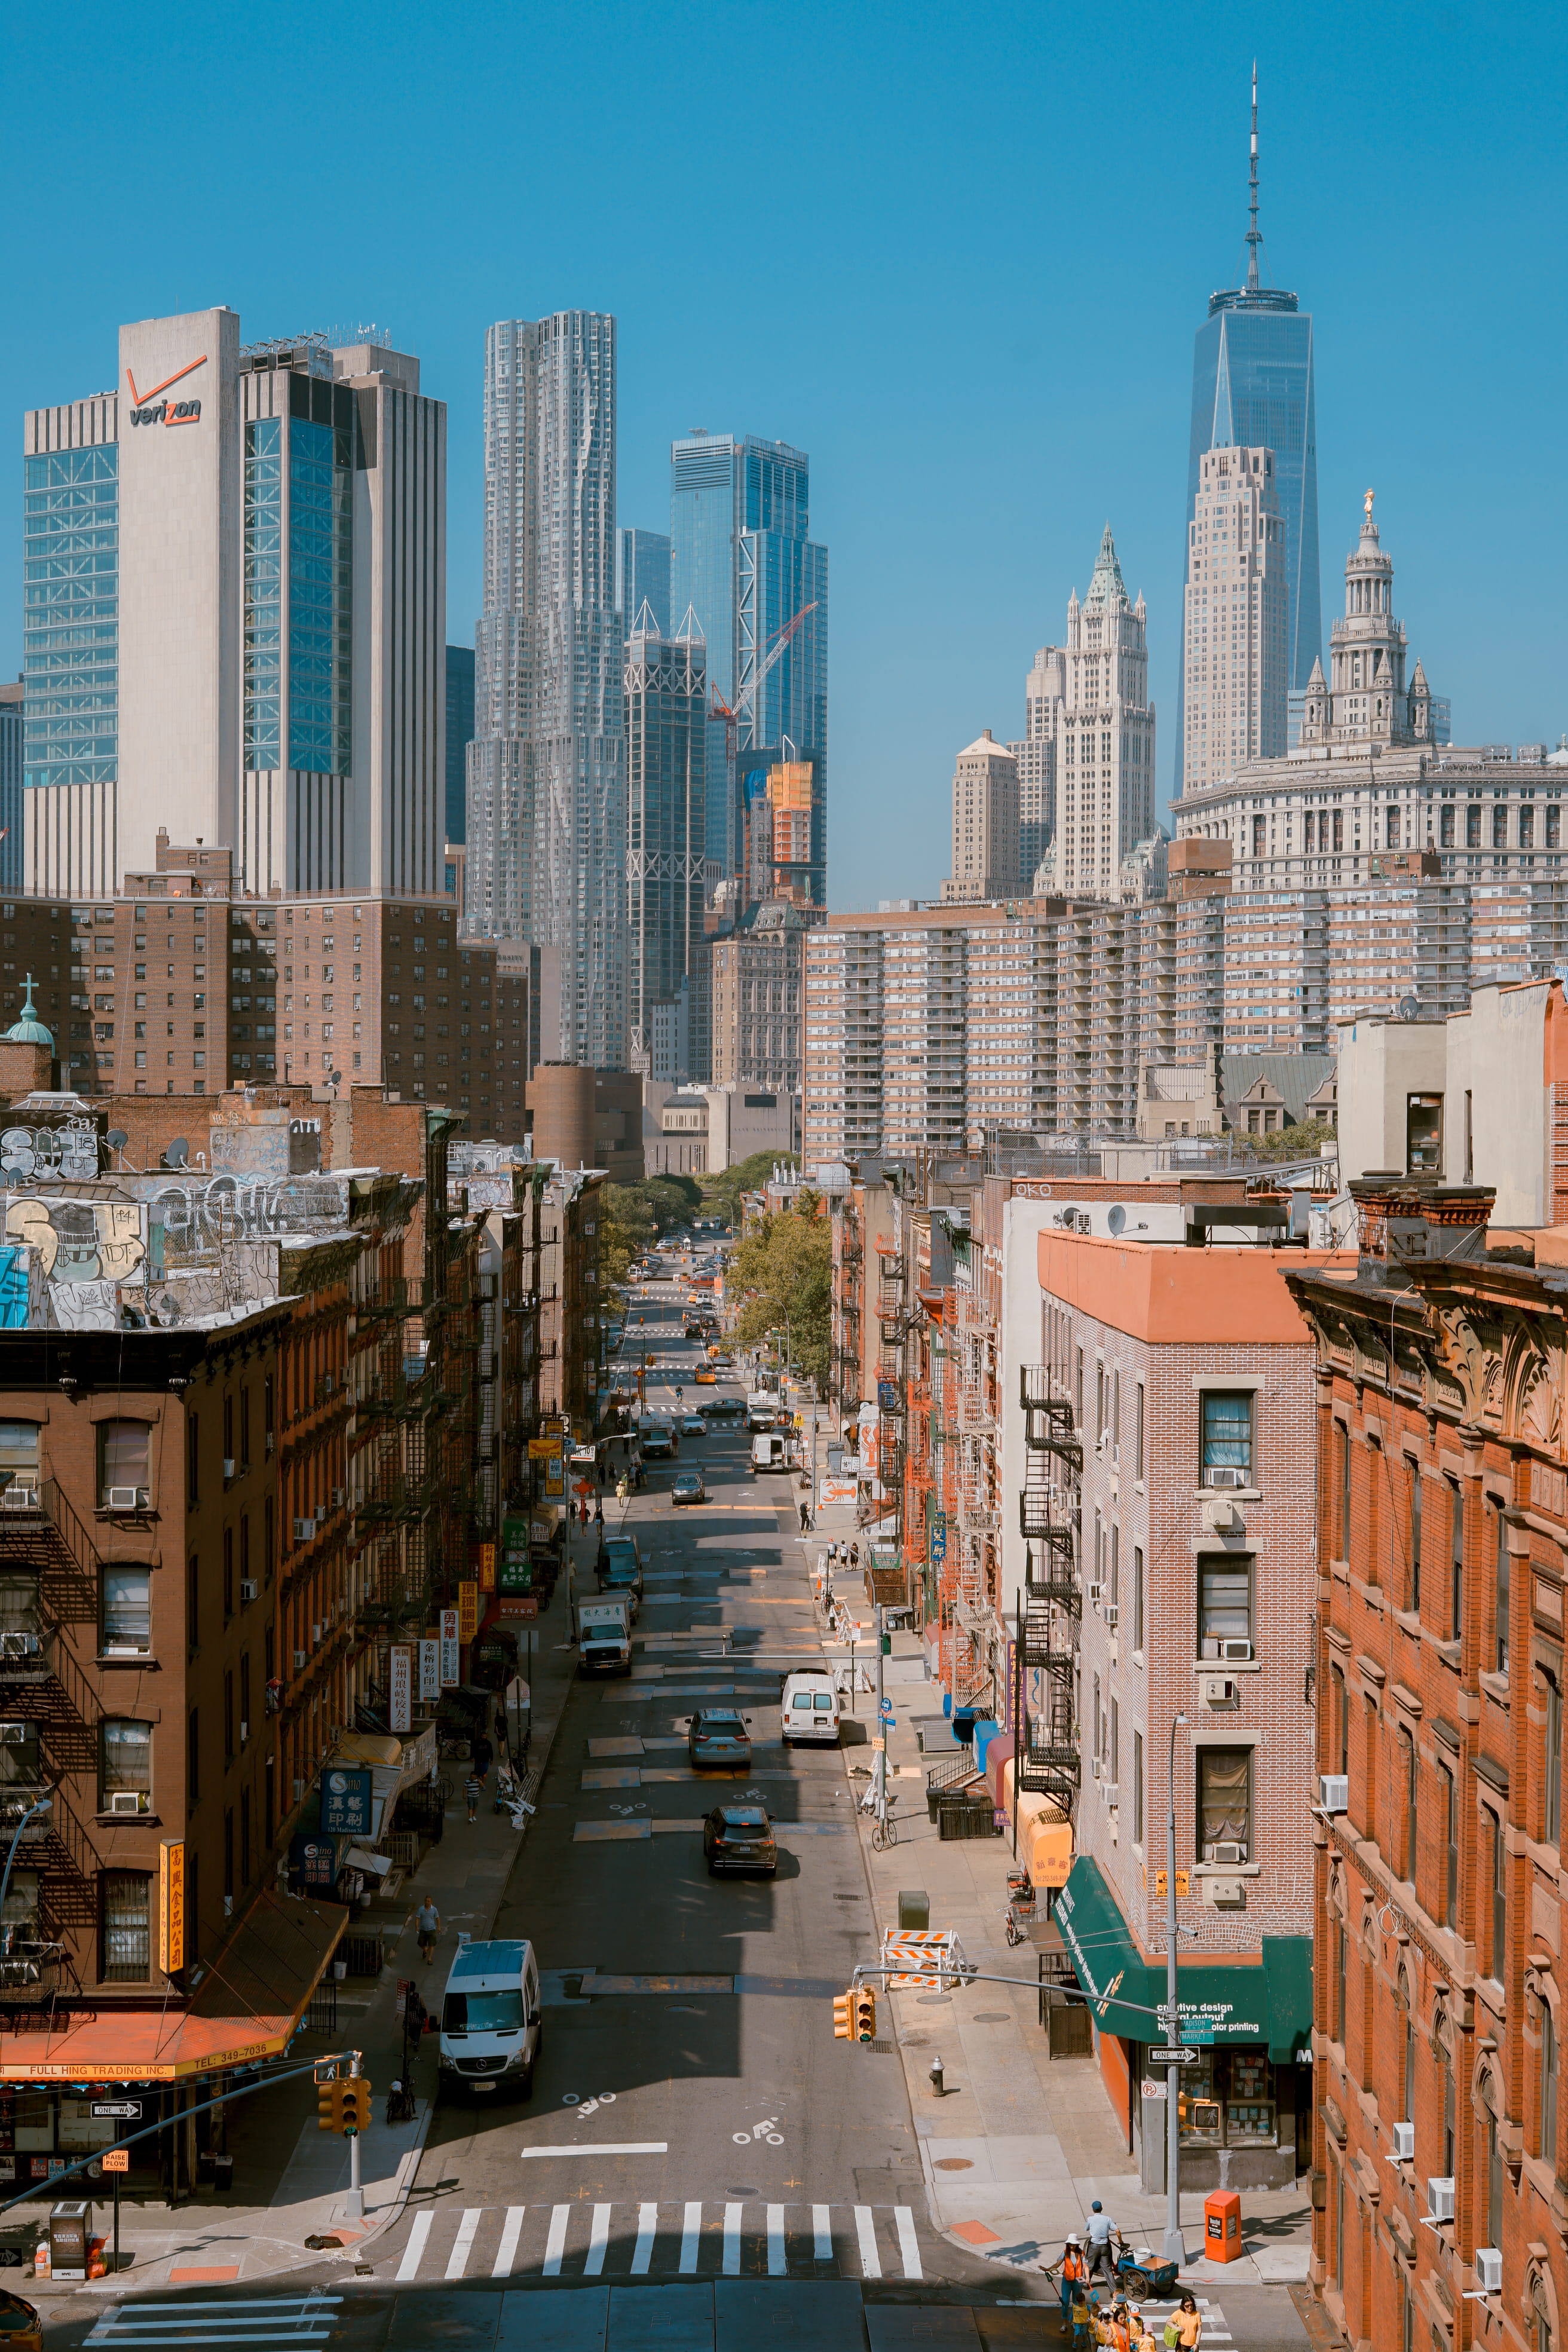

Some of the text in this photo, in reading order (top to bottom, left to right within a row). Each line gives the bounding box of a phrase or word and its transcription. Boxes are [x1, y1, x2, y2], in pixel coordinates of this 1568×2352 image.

[130, 399, 201, 425] verizon
[79, 1137, 96, 1149] 18
[1016, 1183, 1051, 1197] OKO
[424, 1643, 435, 1686] 金榕彩印
[330, 1774, 361, 1791] Sino
[329, 1812, 363, 1827] 印刷
[172, 1849, 182, 1966] 富興食品公司
[1157, 2003, 1233, 2013] crtive design
[1211, 2022, 1227, 2031] olor
[1229, 2022, 1260, 2033] printing
[195, 2044, 267, 2068] TEL: 349-7036
[30, 2066, 167, 2075] FULL HING TRADING INC.
[0, 2253, 13, 2262] AY
